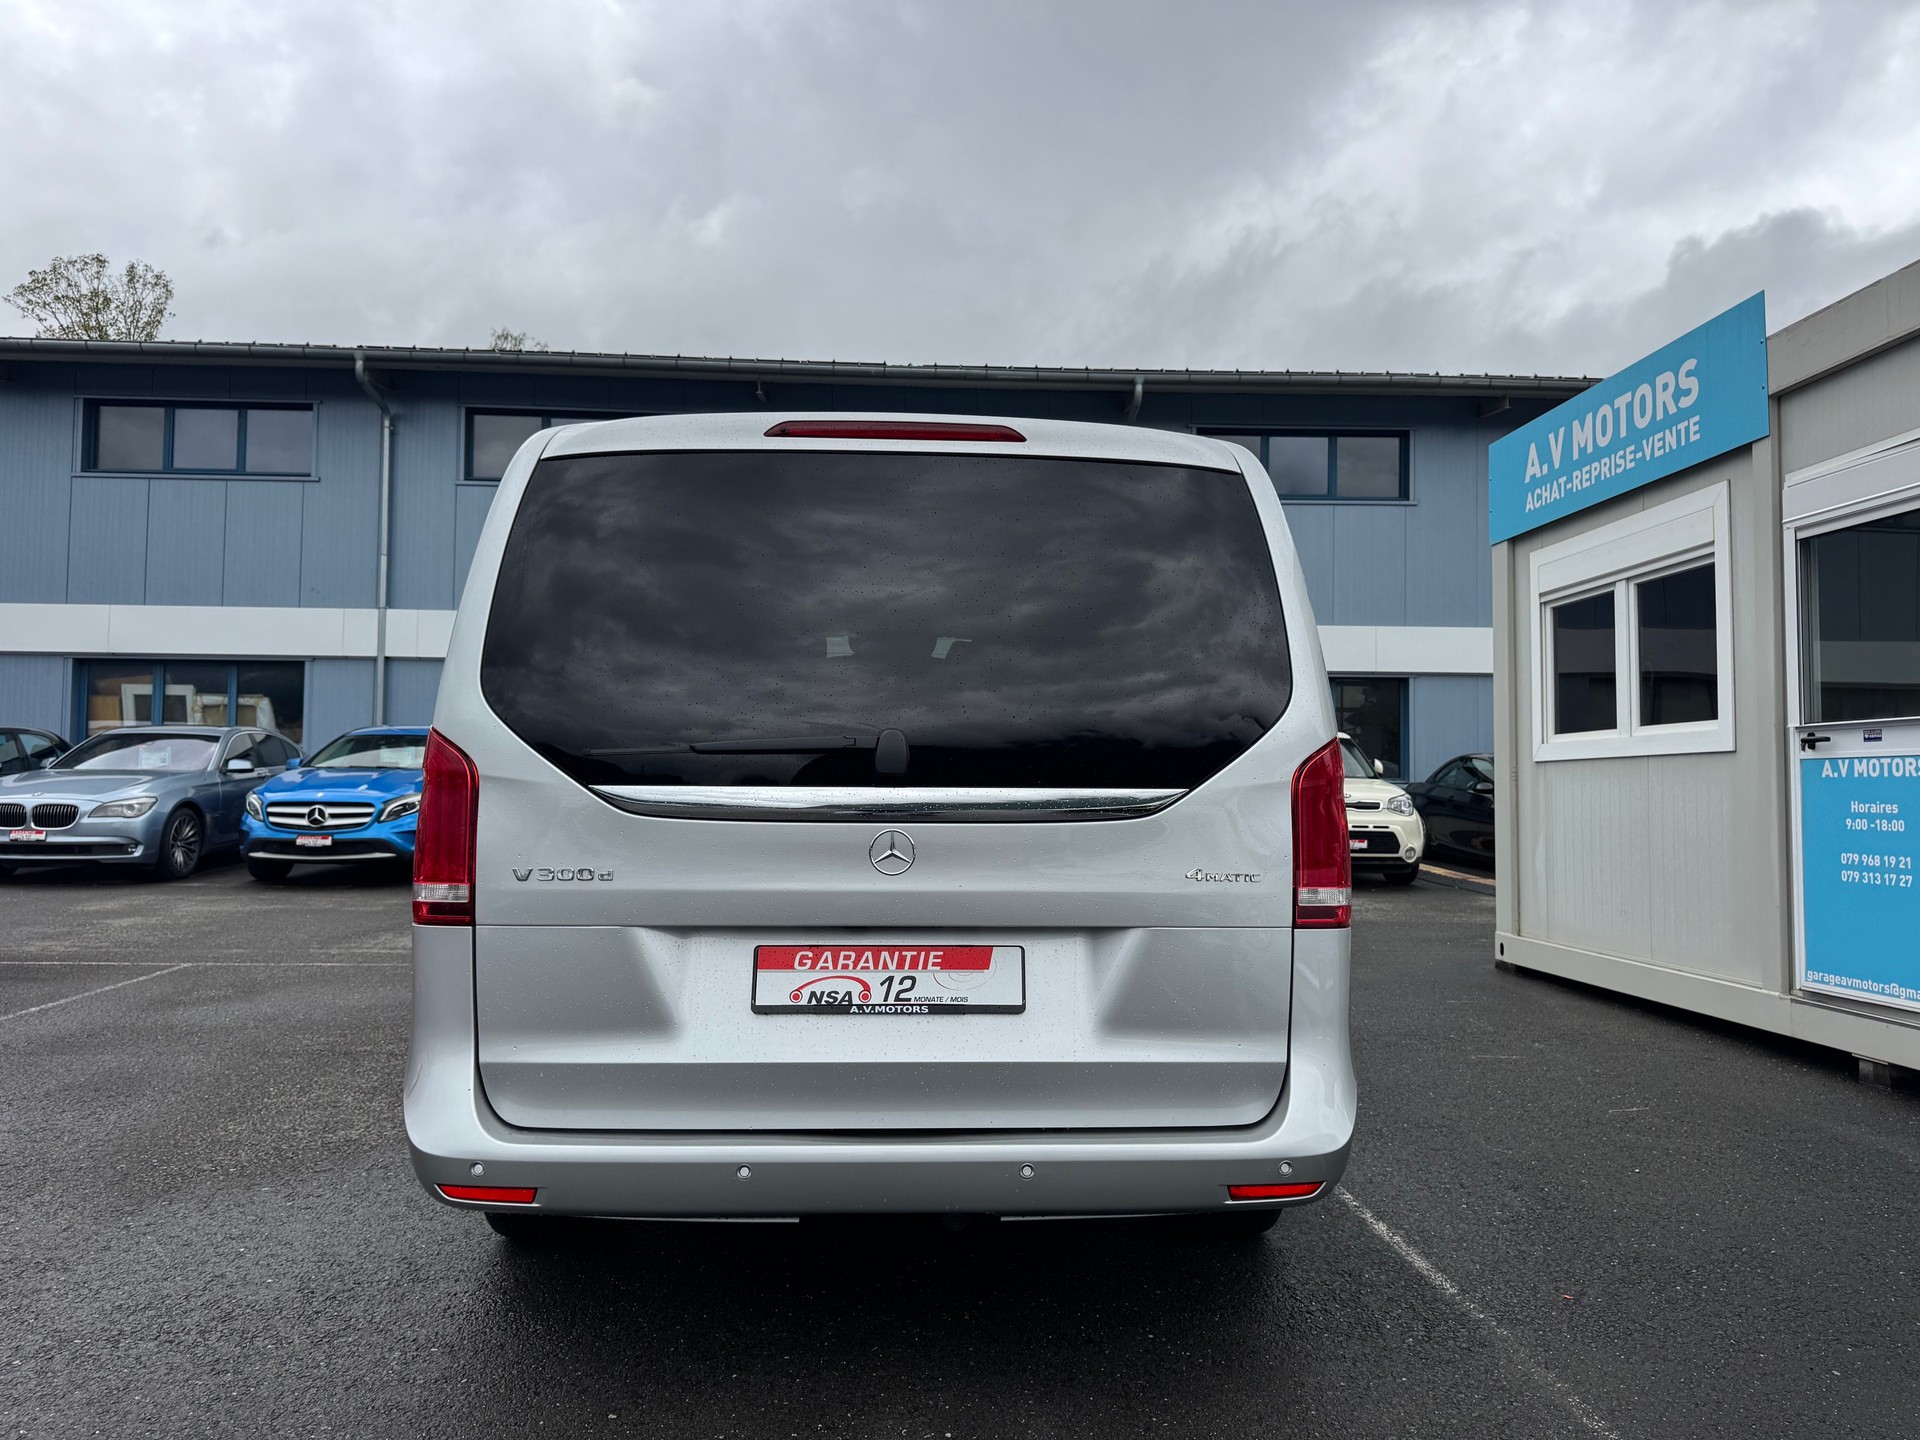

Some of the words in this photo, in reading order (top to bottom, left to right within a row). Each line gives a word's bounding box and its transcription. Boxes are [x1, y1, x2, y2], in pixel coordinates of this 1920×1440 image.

[1525, 427, 1564, 483] A.V
[1572, 358, 1699, 461] MOTORS
[1525, 415, 1700, 513] ACHAT-REPRISE-VENTE
[1821, 759, 1849, 778] A.V
[1850, 800, 1899, 813] Horaires
[1845, 818, 1868, 830] 9:00
[1840, 852, 1859, 865] 079
[1861, 854, 1881, 867] 968
[1883, 855, 1896, 868] 19
[1898, 856, 1912, 869] 21
[1184, 868, 1262, 883] 4MATIC
[1841, 870, 1860, 883] 079
[1862, 871, 1881, 885] 313
[1883, 873, 1897, 886] 17
[1899, 875, 1913, 888] 27
[793, 951, 944, 971] GARANTIE
[807, 991, 854, 1005] NSA
[879, 975, 917, 1003] 12
[849, 1005, 930, 1014] A.V.MOTORS
